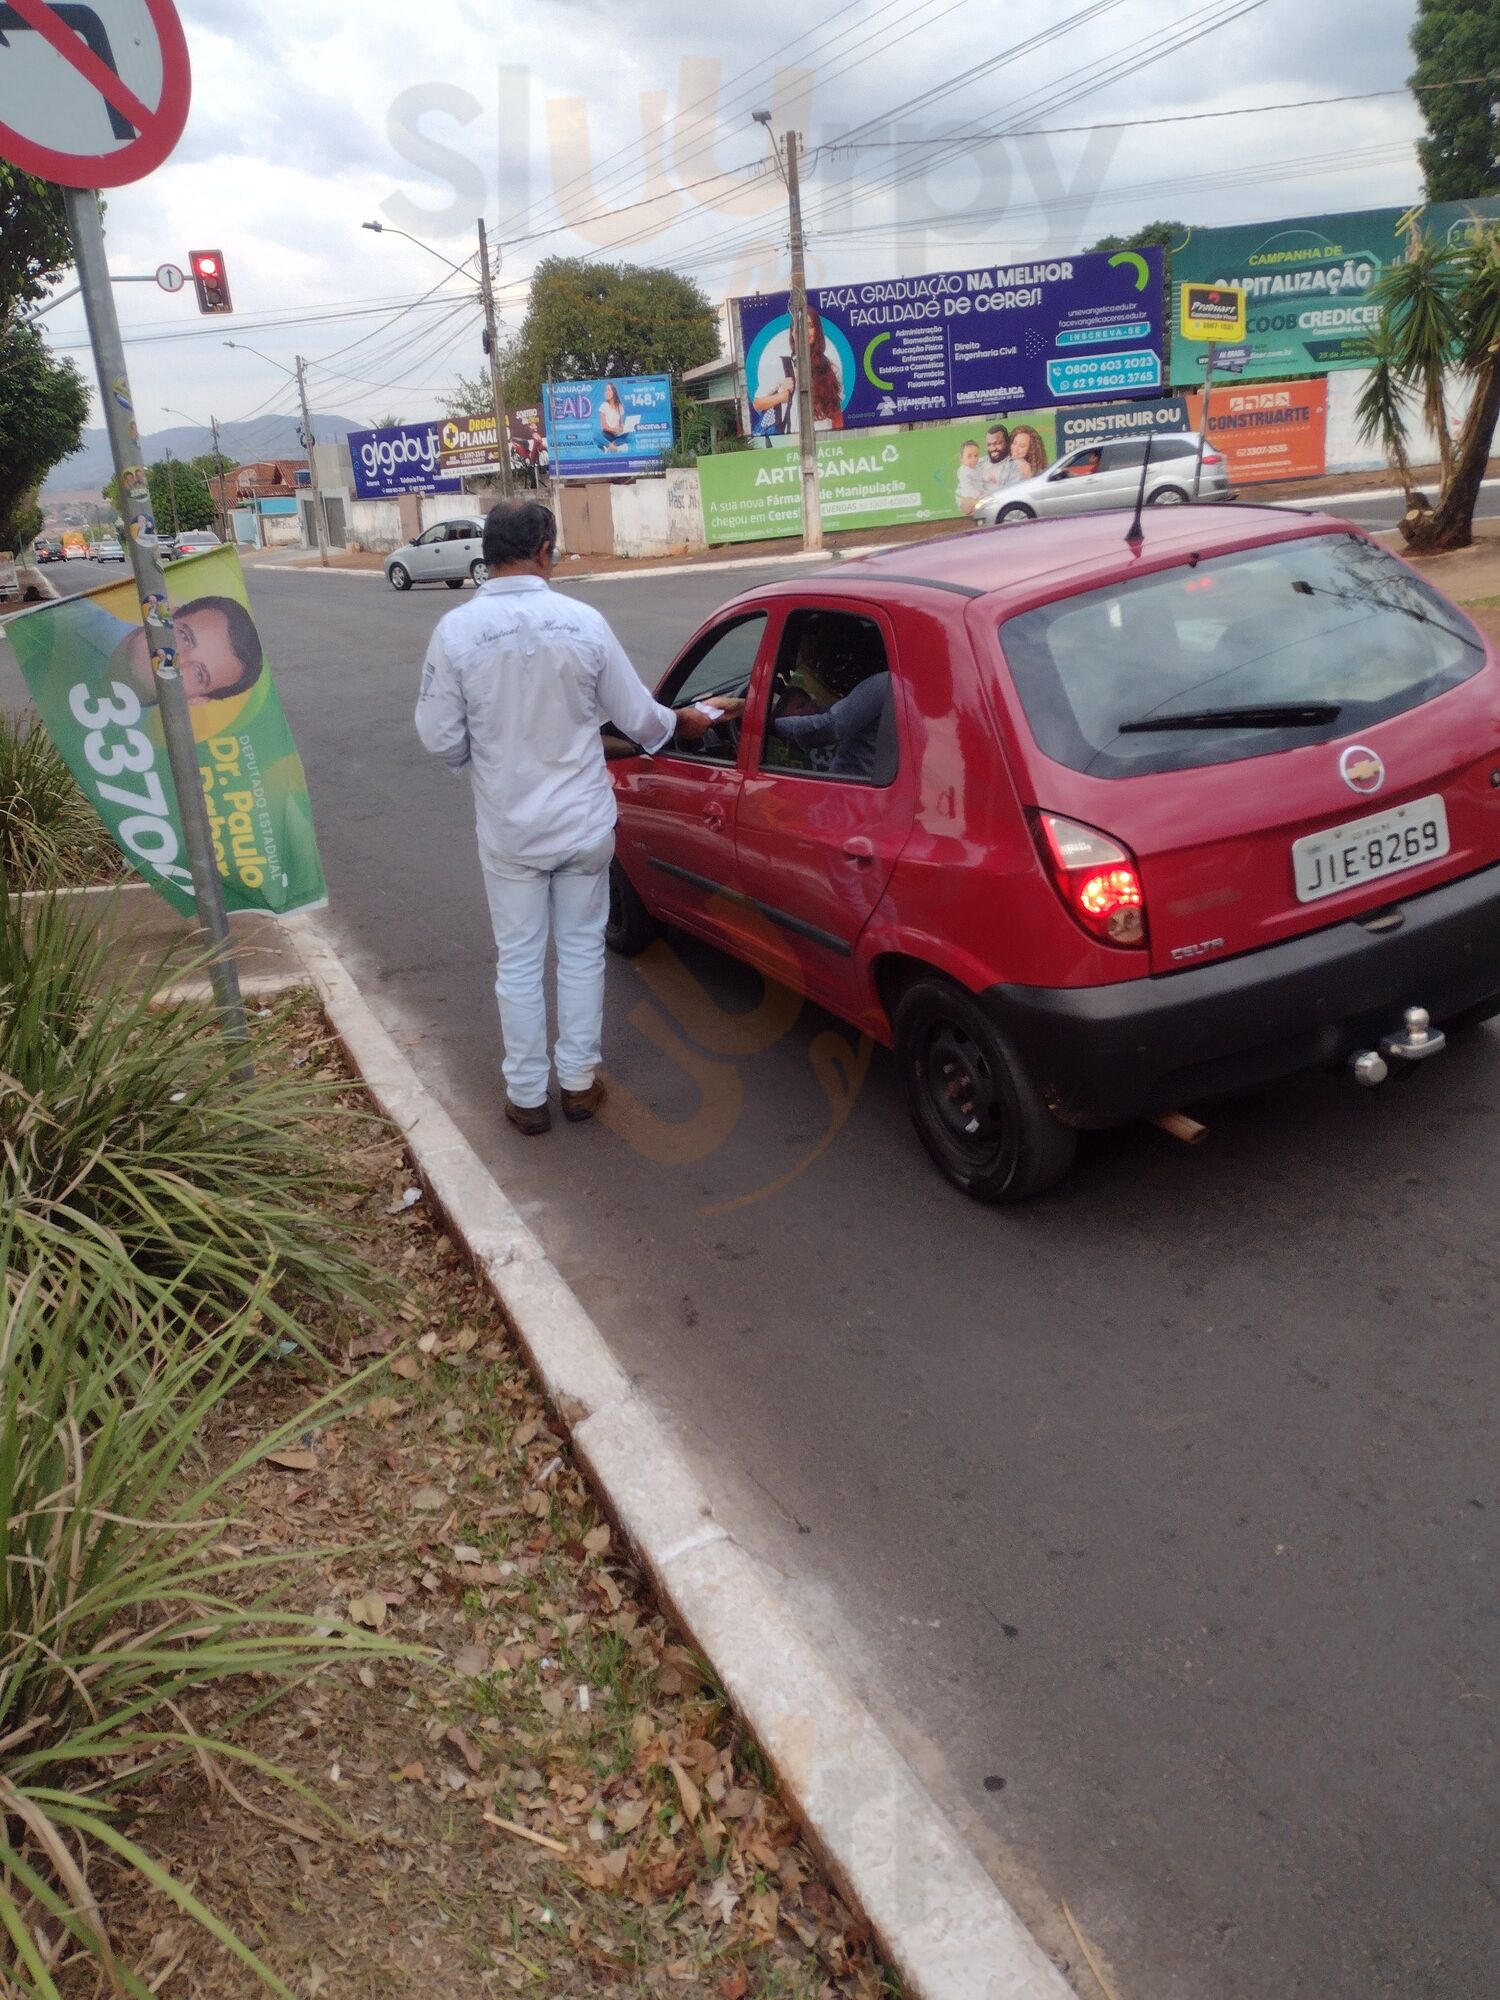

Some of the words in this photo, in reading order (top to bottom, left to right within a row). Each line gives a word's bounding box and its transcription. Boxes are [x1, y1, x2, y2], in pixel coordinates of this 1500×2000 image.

[1249, 248, 1321, 266] CAMPANHA
[1324, 245, 1343, 256] DE
[819, 288, 857, 311] FAÇA
[861, 272, 963, 304] GRADUAÇÃO
[967, 271, 995, 291] NA
[997, 262, 1074, 286] MELHOR
[895, 325, 943, 337] Administração
[1247, 314, 1297, 333] COOB
[903, 335, 943, 345] Biomedicina
[1069, 326, 1141, 341] INSCREVA-SE
[892, 345, 924, 356] Educação
[955, 342, 980, 351] Direito
[955, 349, 999, 361] Engenharia
[1000, 346, 1017, 356] Civil
[902, 352, 944, 363] Enfermagem
[1065, 363, 1098, 375] 0800
[1100, 360, 1121, 371] 603
[1124, 357, 1153, 369] 2023
[879, 366, 904, 375] Estética
[910, 361, 944, 371] Cosmética
[914, 370, 944, 379] Farmácia
[908, 379, 945, 389] Fisioterapia
[1072, 379, 1085, 389] 62
[1088, 377, 1095, 386] 9
[1096, 375, 1125, 386] 9802
[1127, 371, 1153, 383] 3765
[469, 415, 509, 431] DROGA
[1064, 411, 1154, 434] CONSTRUIR
[1156, 408, 1181, 424] OU
[1207, 406, 1310, 431] CONSTRUARTE
[460, 427, 511, 447] PLANAL
[361, 428, 440, 477] gigabyt
[786, 446, 844, 463] FAÁCIA
[755, 455, 884, 487] ARTSANAL
[710, 501, 718, 512] A
[720, 502, 737, 512] sua
[740, 499, 764, 510] nova
[767, 494, 801, 506] Fárma
[819, 488, 833, 500] de
[835, 480, 906, 498] Manipulação
[712, 516, 747, 528] chegou
[750, 514, 766, 523] em
[208, 736, 241, 786] Dr.
[239, 734, 266, 808] DEPUTADO
[259, 810, 282, 881] ESTADUAL
[223, 791, 267, 888] Paulo
